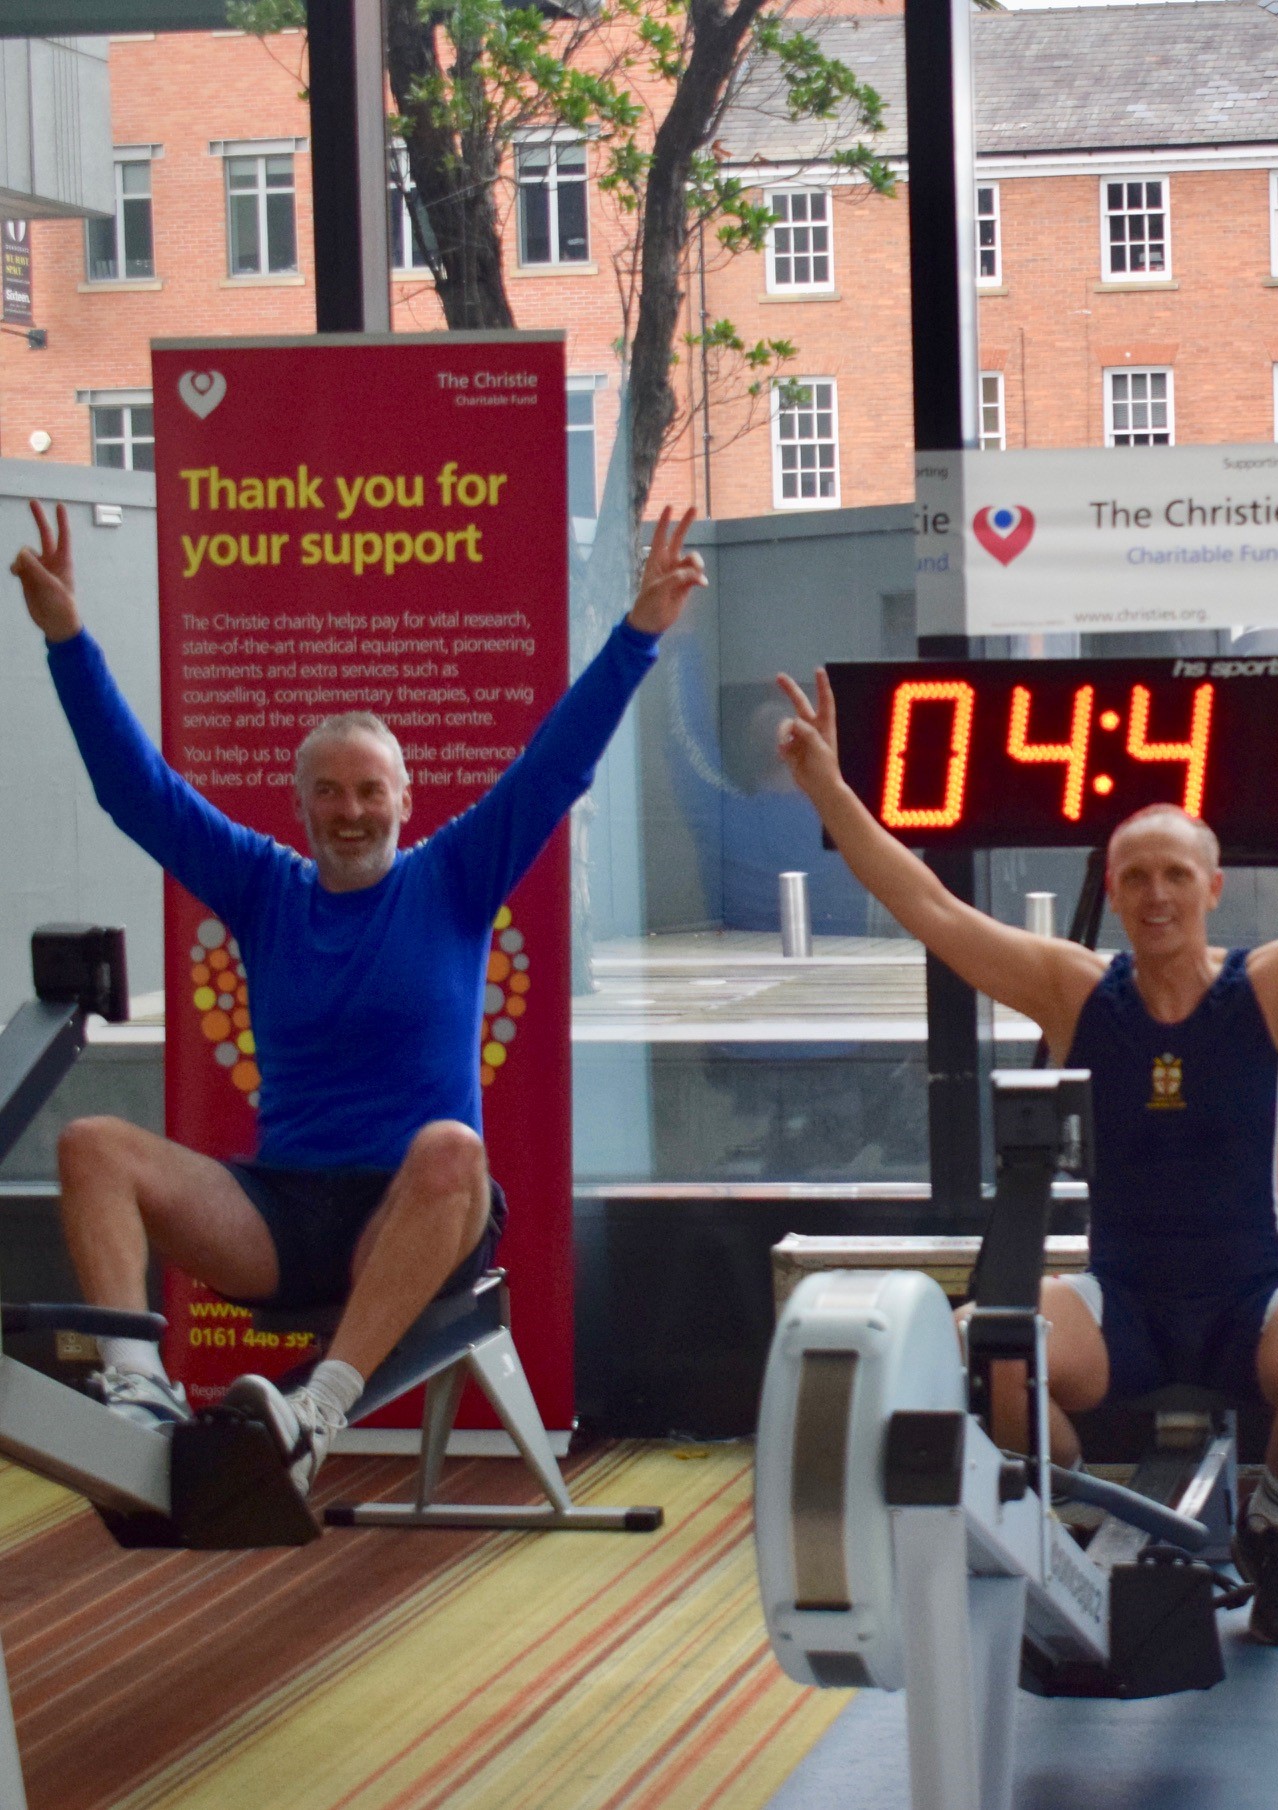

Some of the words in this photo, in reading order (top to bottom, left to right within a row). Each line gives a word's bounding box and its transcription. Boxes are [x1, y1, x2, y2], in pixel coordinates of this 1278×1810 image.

[437, 371, 470, 389] The
[473, 370, 538, 389] Christie
[455, 394, 508, 406] Charitable
[511, 394, 538, 405] Fund
[179, 463, 325, 512] Thank
[335, 473, 424, 520] you
[437, 460, 508, 507] for
[1090, 500, 1152, 529] The
[181, 532, 290, 578] your
[301, 523, 484, 576] support
[1126, 544, 1234, 566] Charitable
[183, 614, 209, 630] The
[213, 613, 270, 630] Christie
[274, 613, 324, 633] charity
[328, 611, 367, 632] helps
[371, 613, 399, 633] pay
[403, 611, 425, 629] for
[429, 611, 460, 628] vital
[463, 611, 531, 629] research,
[182, 637, 295, 655] state-of-the-art
[299, 637, 357, 654] medical
[361, 637, 449, 656] equipment,
[453, 635, 535, 656] pioneering
[183, 664, 263, 679] treatments
[267, 662, 297, 678] and
[301, 663, 338, 678] extra
[341, 662, 399, 678] services
[403, 660, 438, 677] such
[442, 664, 459, 677] as
[1172, 658, 1207, 678] hs
[183, 686, 270, 707] counselling,
[274, 686, 394, 706] complementary
[397, 685, 471, 704] therapies,
[474, 688, 500, 701] our
[504, 685, 534, 704] wig
[183, 711, 231, 728] service
[236, 710, 265, 728] and
[269, 710, 295, 728] the
[445, 710, 497, 726] centre.
[184, 746, 212, 762] You
[216, 745, 249, 765] help
[253, 750, 270, 762] us
[275, 748, 291, 762] to
[441, 742, 516, 760] difference
[212, 769, 243, 785] lives
[246, 768, 263, 785] of
[418, 768, 453, 785] their
[190, 1327, 236, 1347] 0161
